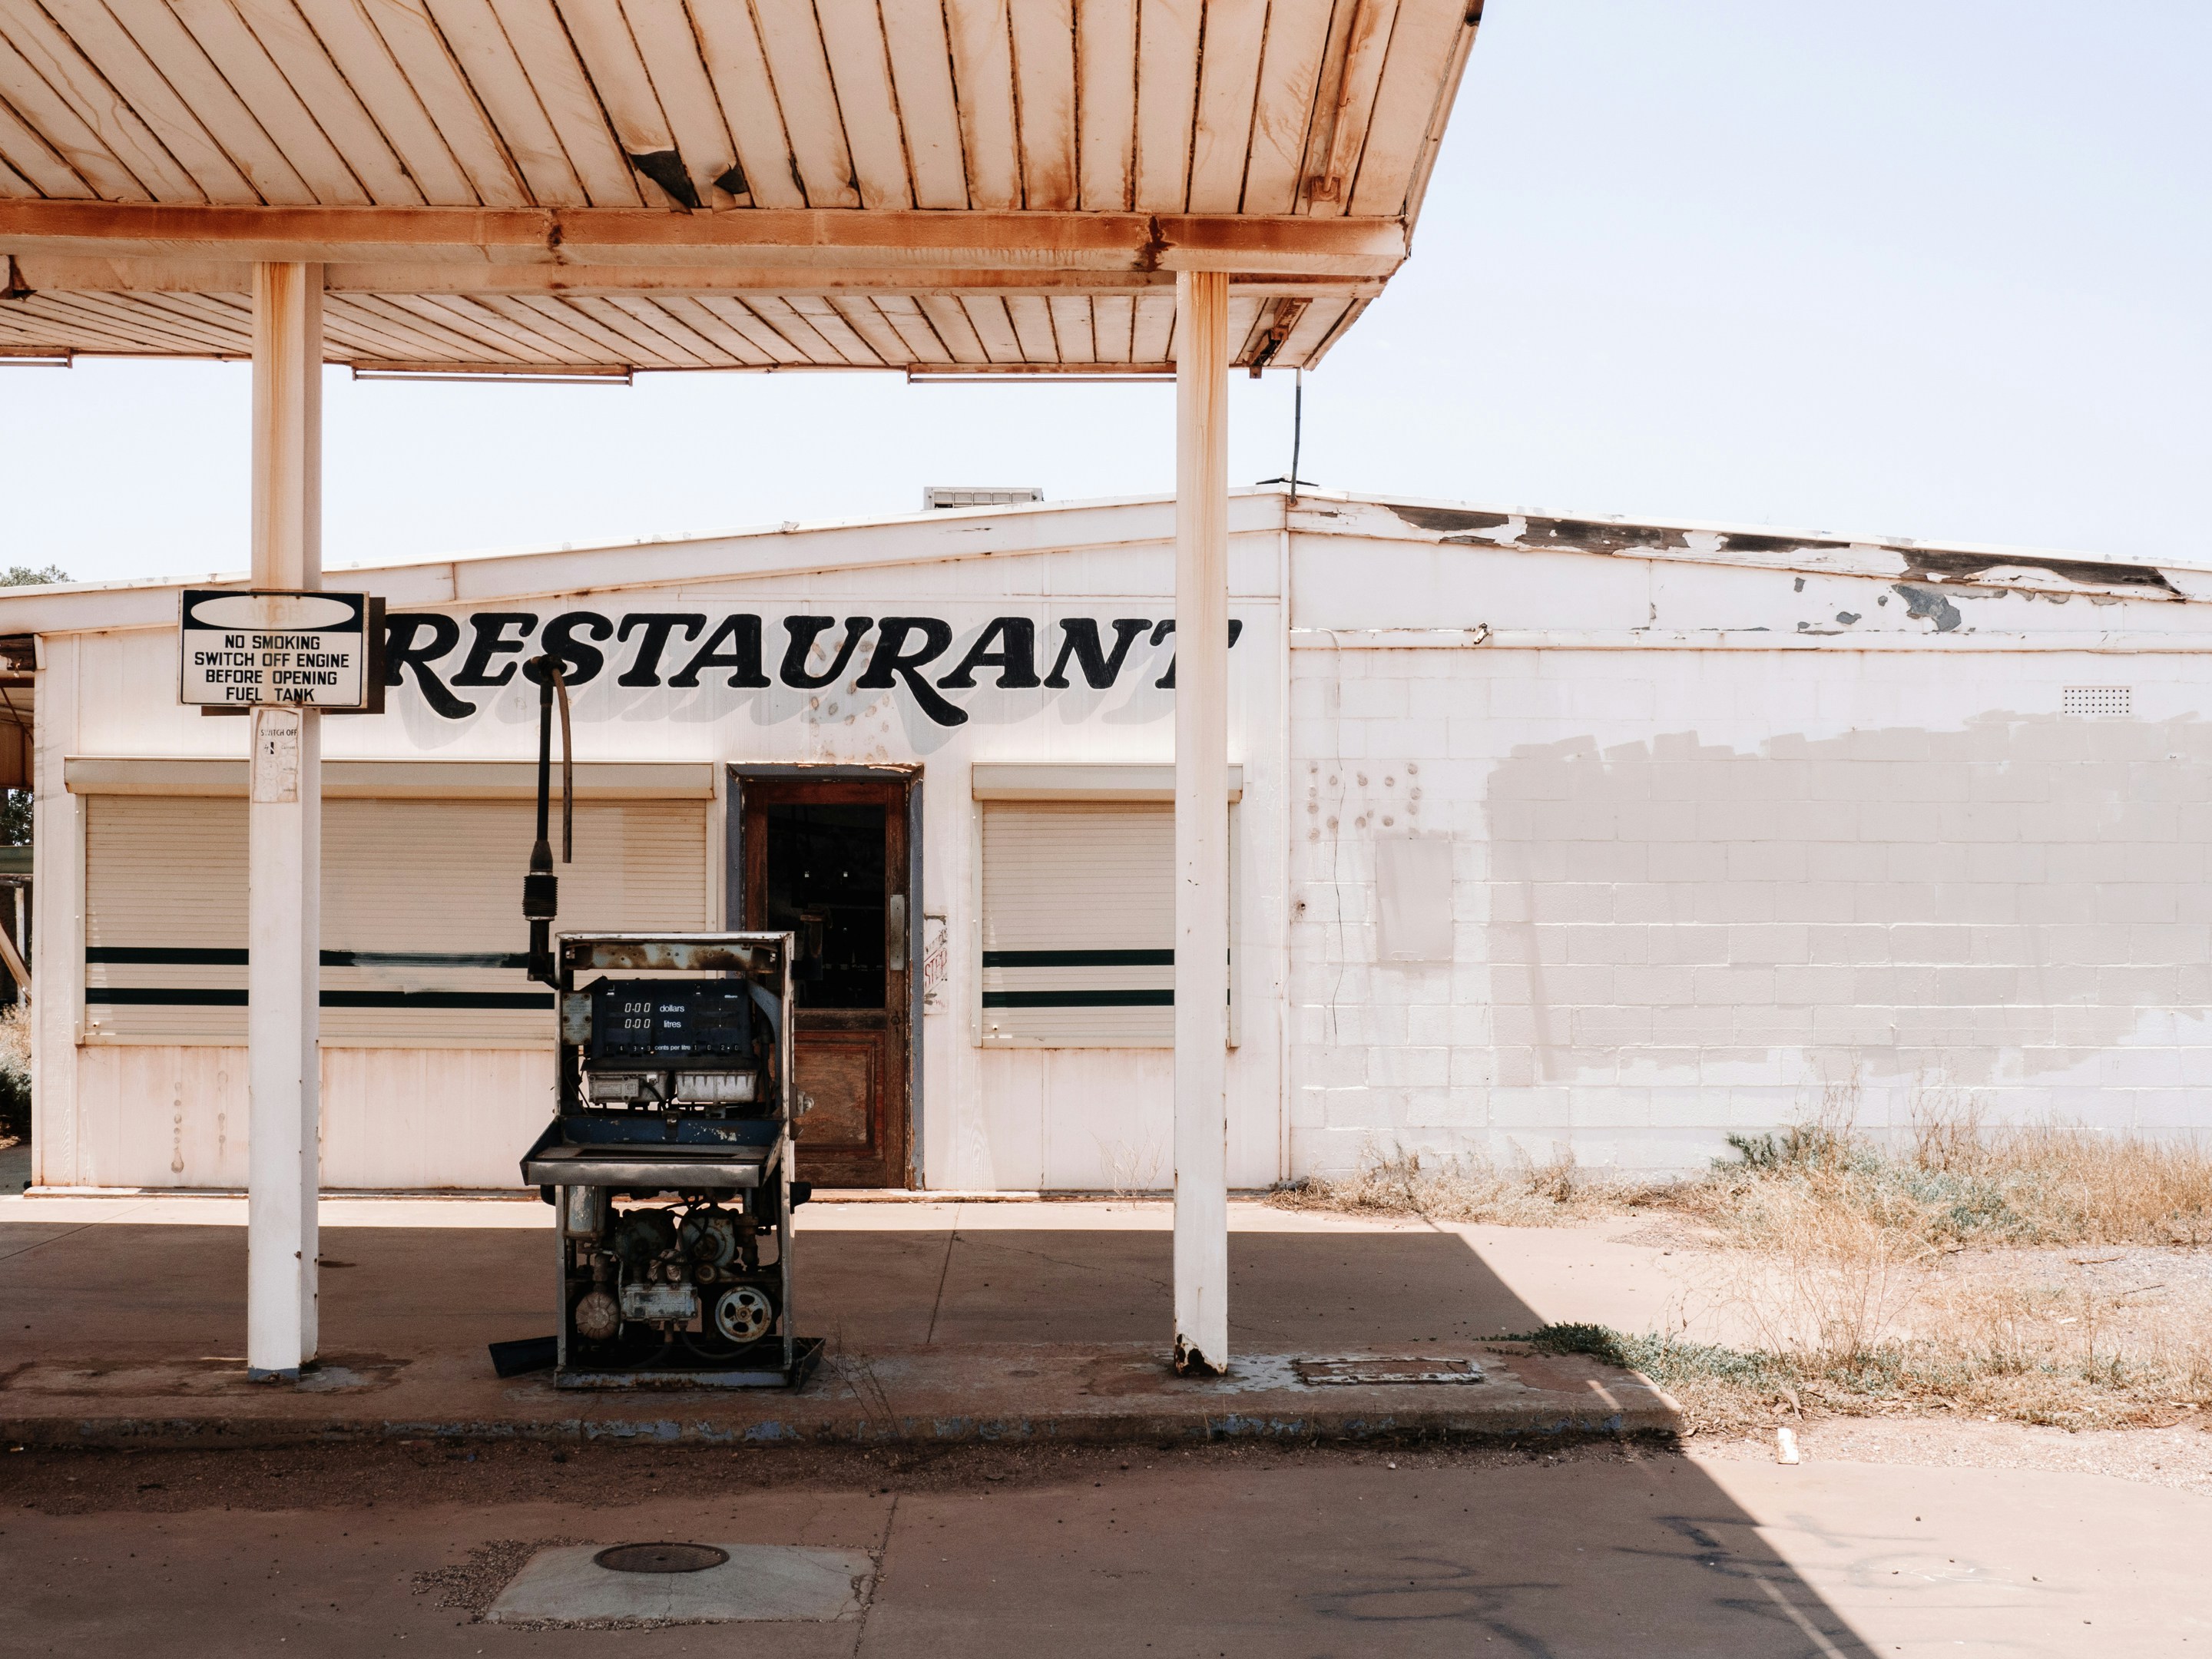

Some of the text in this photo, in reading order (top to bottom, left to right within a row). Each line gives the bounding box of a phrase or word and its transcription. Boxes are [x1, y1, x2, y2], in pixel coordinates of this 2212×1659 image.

[225, 634, 320, 650] NO SMOKING
[194, 651, 349, 668] SWITCH OFF ENGINE
[206, 669, 337, 685] BEFORE OPENING
[226, 687, 315, 702] FUEL TANK
[659, 1004, 685, 1012] dollars
[664, 1020, 682, 1028] litres
